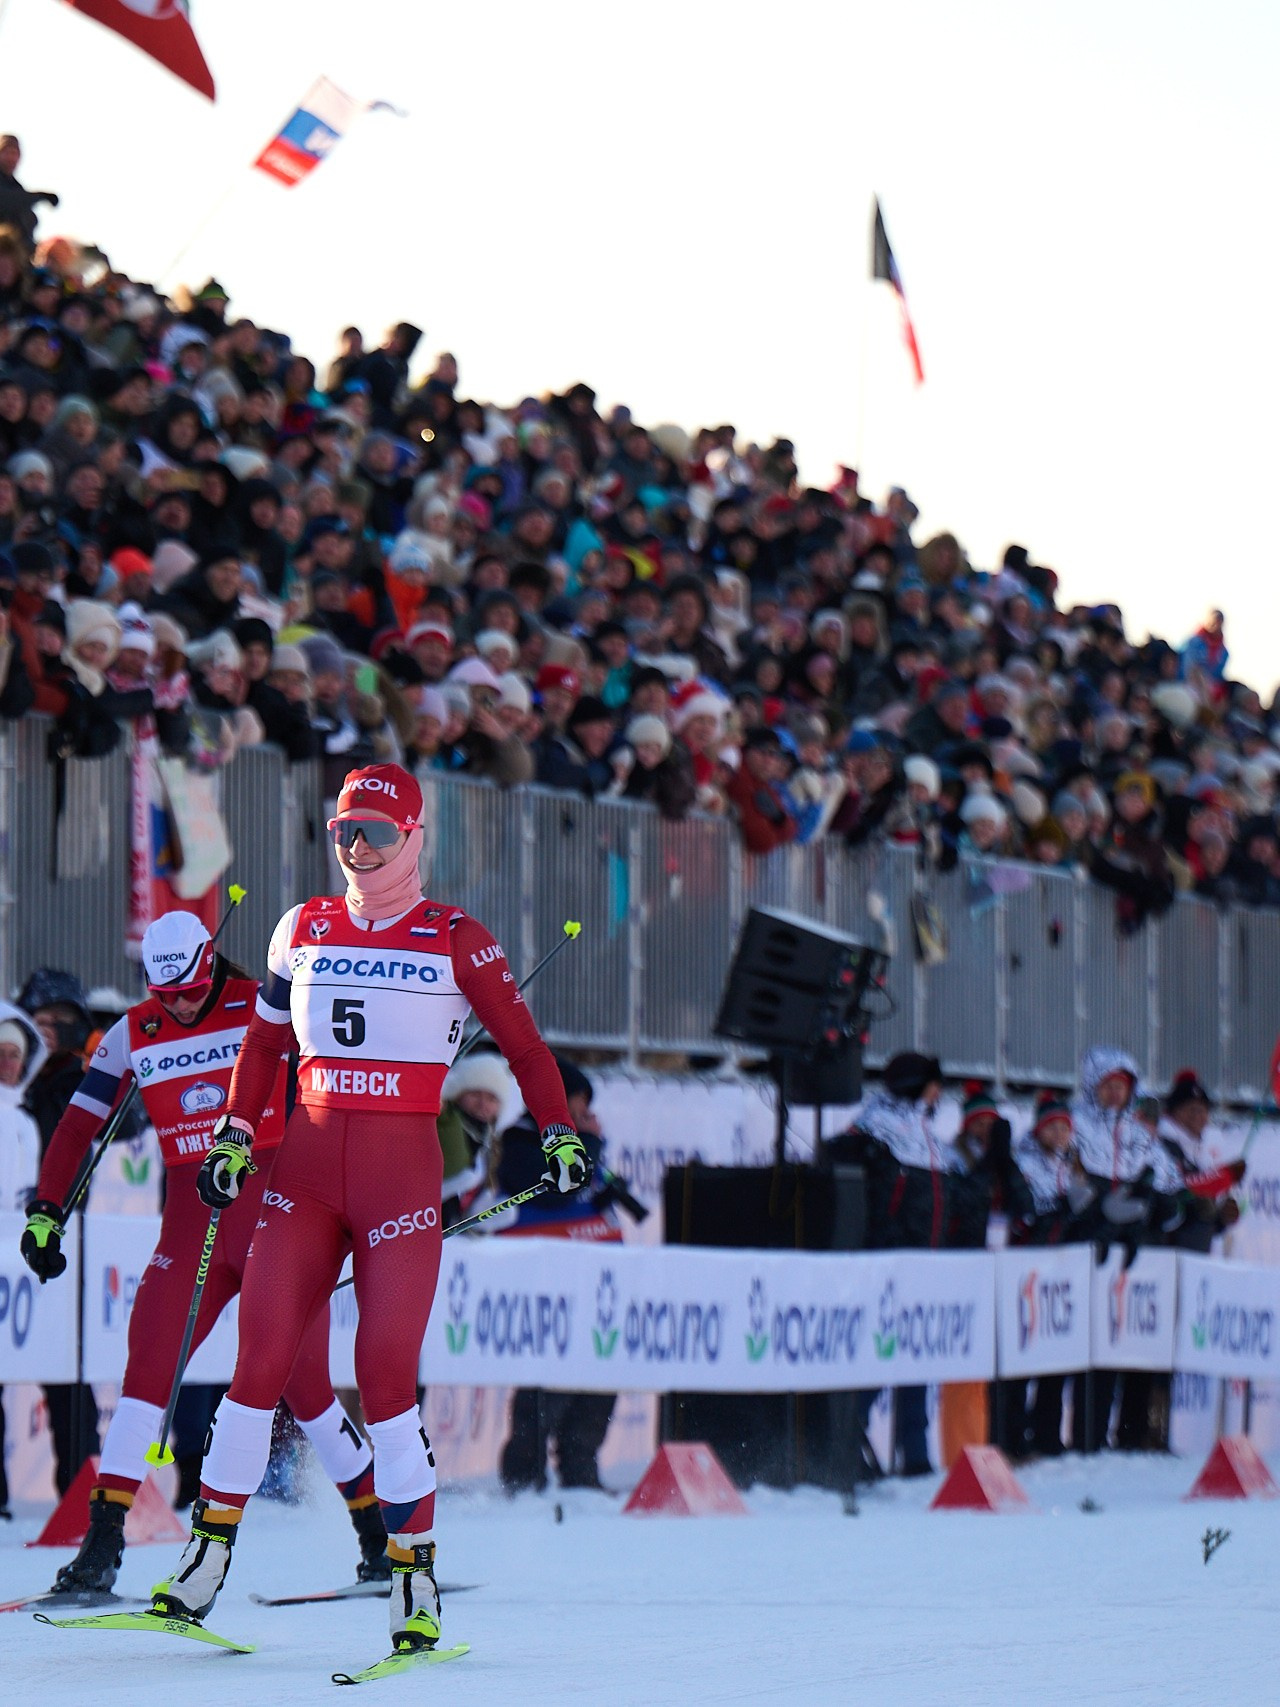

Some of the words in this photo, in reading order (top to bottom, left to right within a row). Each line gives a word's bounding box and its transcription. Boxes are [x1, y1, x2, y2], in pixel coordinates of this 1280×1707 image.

[340, 778, 399, 800] UKOIL
[152, 952, 188, 964] LUKOIL
[311, 957, 439, 984] ФОСАГРО
[331, 998, 366, 1048] 5
[310, 1067, 402, 1097] ИЖЕВСК
[177, 1115, 220, 1132] России
[175, 1133, 219, 1155] ИЖЕ
[368, 1206, 437, 1249] BOSCO
